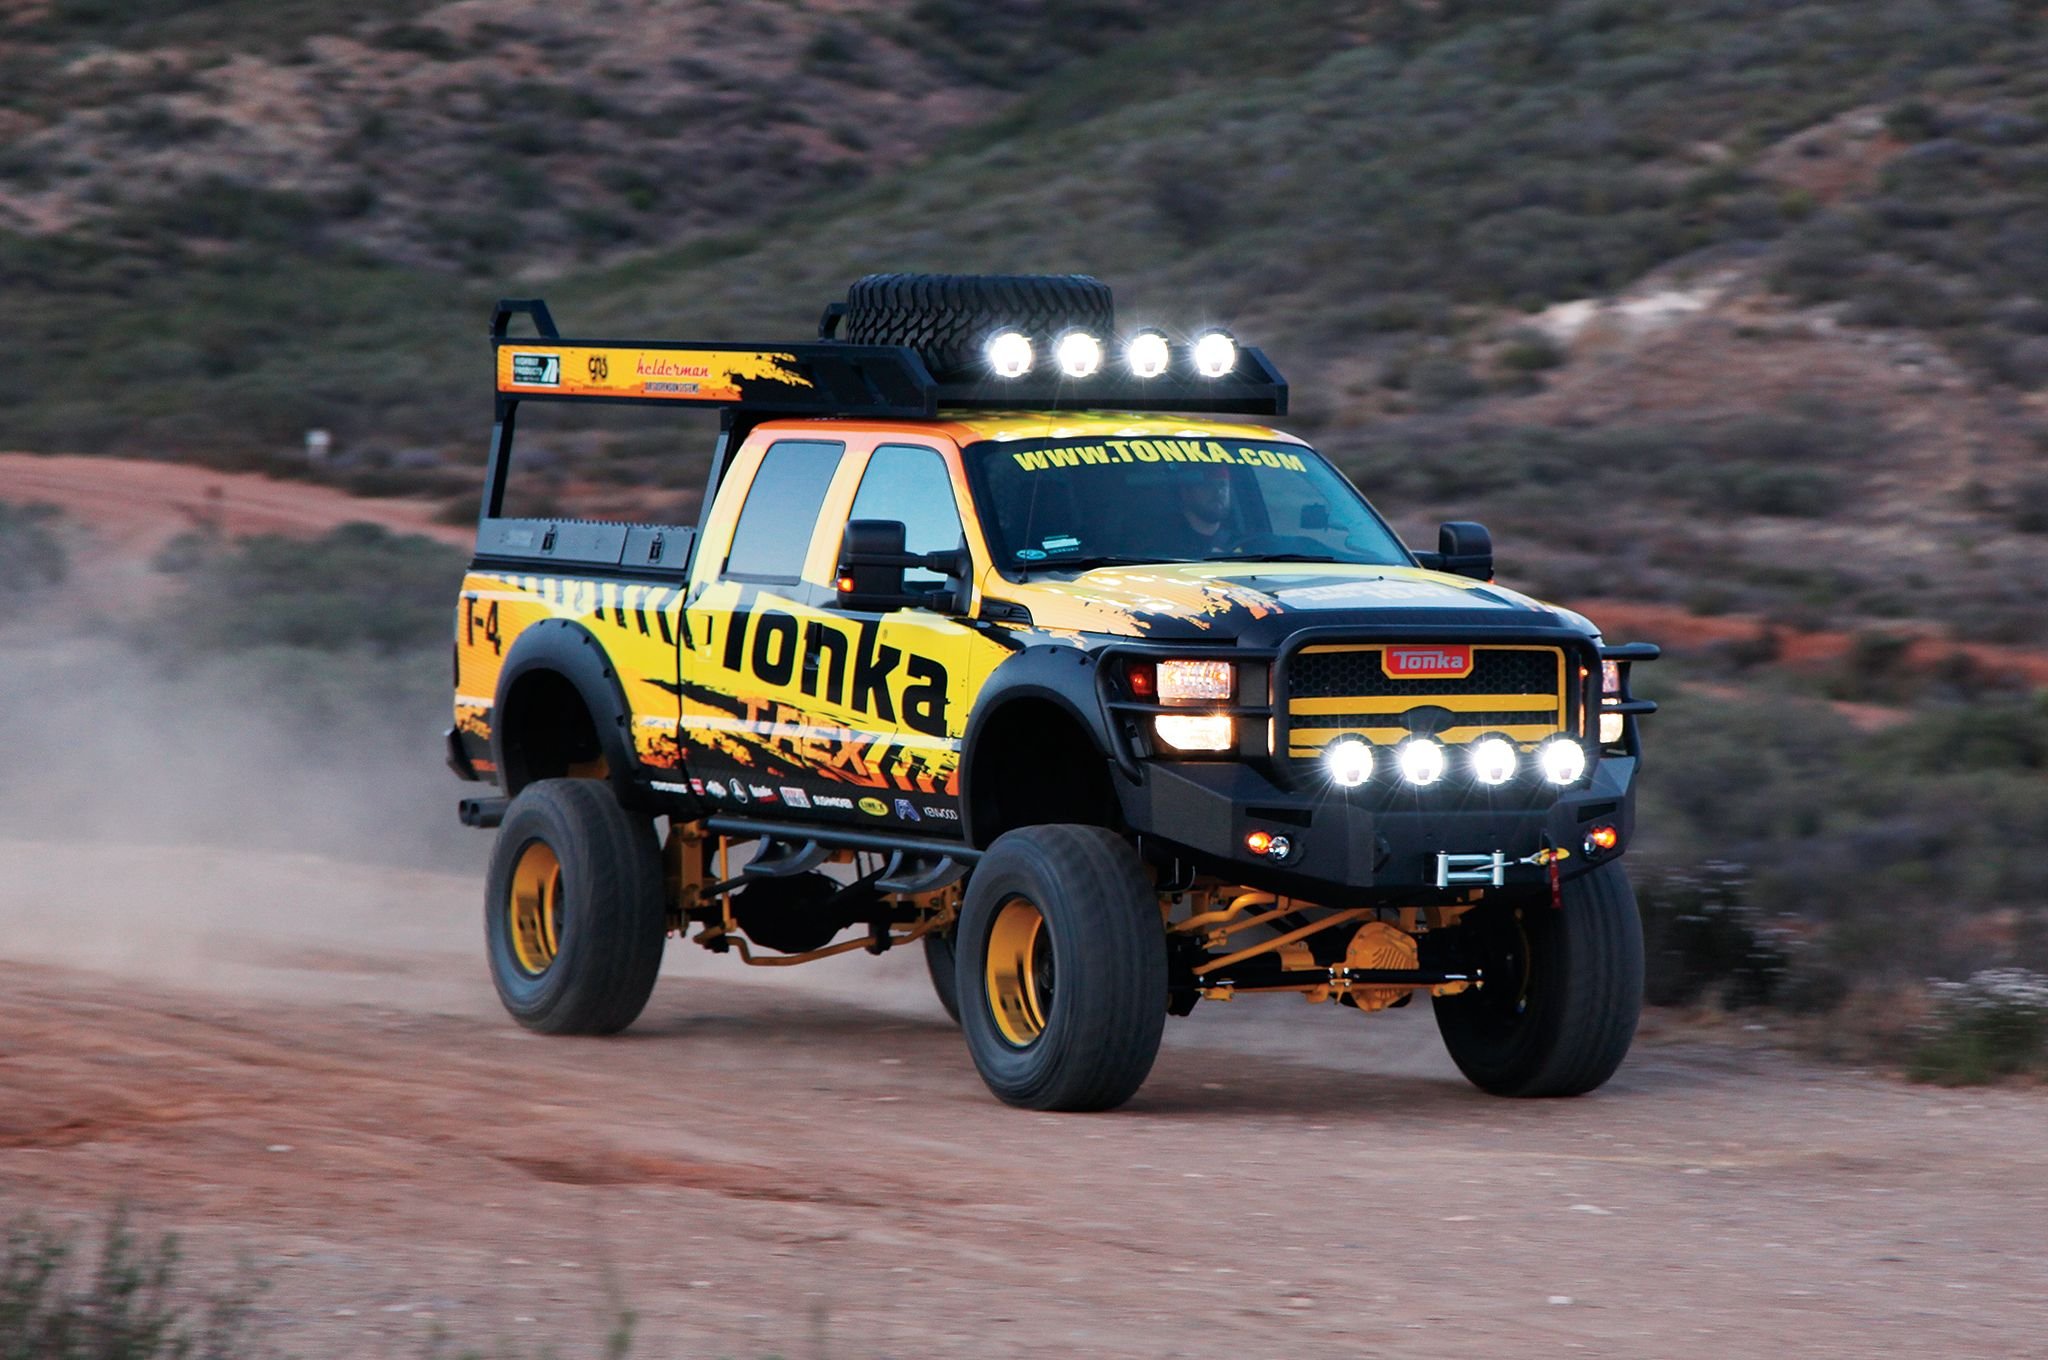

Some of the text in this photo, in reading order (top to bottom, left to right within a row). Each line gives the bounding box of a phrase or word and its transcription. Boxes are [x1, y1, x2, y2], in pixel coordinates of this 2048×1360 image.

[636, 357, 711, 377] helderman
[1013, 440, 1307, 472] WWW.TONKA.COM
[464, 592, 501, 656] T-4
[722, 597, 949, 738] Tonka
[1393, 651, 1464, 669] Tonka
